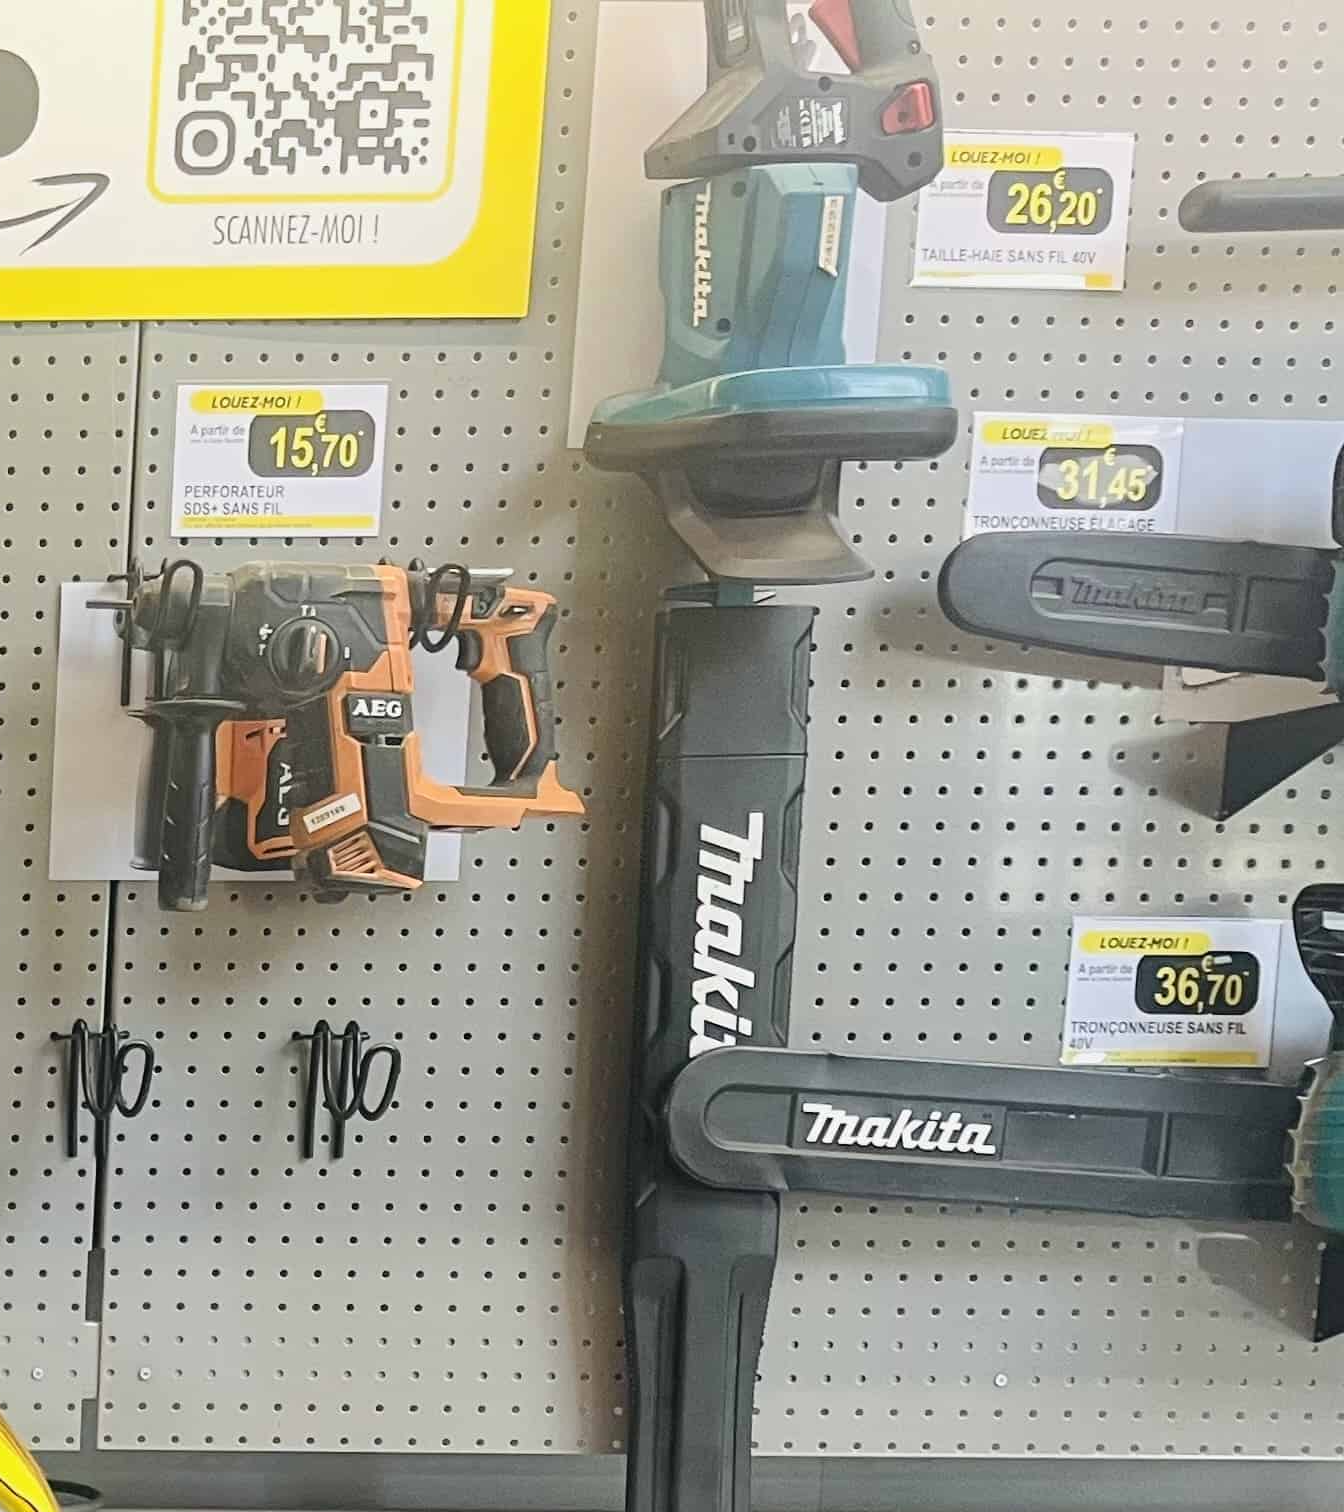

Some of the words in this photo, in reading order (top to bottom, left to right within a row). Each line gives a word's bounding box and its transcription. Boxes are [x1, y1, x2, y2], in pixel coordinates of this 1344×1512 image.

[951, 152, 1030, 164] LOUEZ-MOI
[212, 214, 362, 246] SCANNEZ-MOI
[370, 214, 380, 244] !
[922, 249, 1002, 262] TAILLE-HAIE
[1009, 250, 1044, 263] SANS
[1049, 251, 1067, 263] FIL
[212, 397, 291, 408] LOUEZ-MOI
[201, 425, 228, 438] partir
[232, 424, 244, 435] de
[184, 486, 284, 498] PERFORATEUR
[223, 503, 258, 515] SANS
[264, 503, 282, 515] FIL
[352, 700, 402, 717] AEG
[1100, 937, 1178, 949] LOUEZ-MOI
[1088, 965, 1117, 976] partir
[1120, 964, 1132, 974] de
[1072, 1021, 1183, 1037] TRONÇONNEUSE
[1187, 1022, 1222, 1034] SANS
[1228, 1022, 1246, 1034] FIL
[802, 1103, 996, 1154] makita
